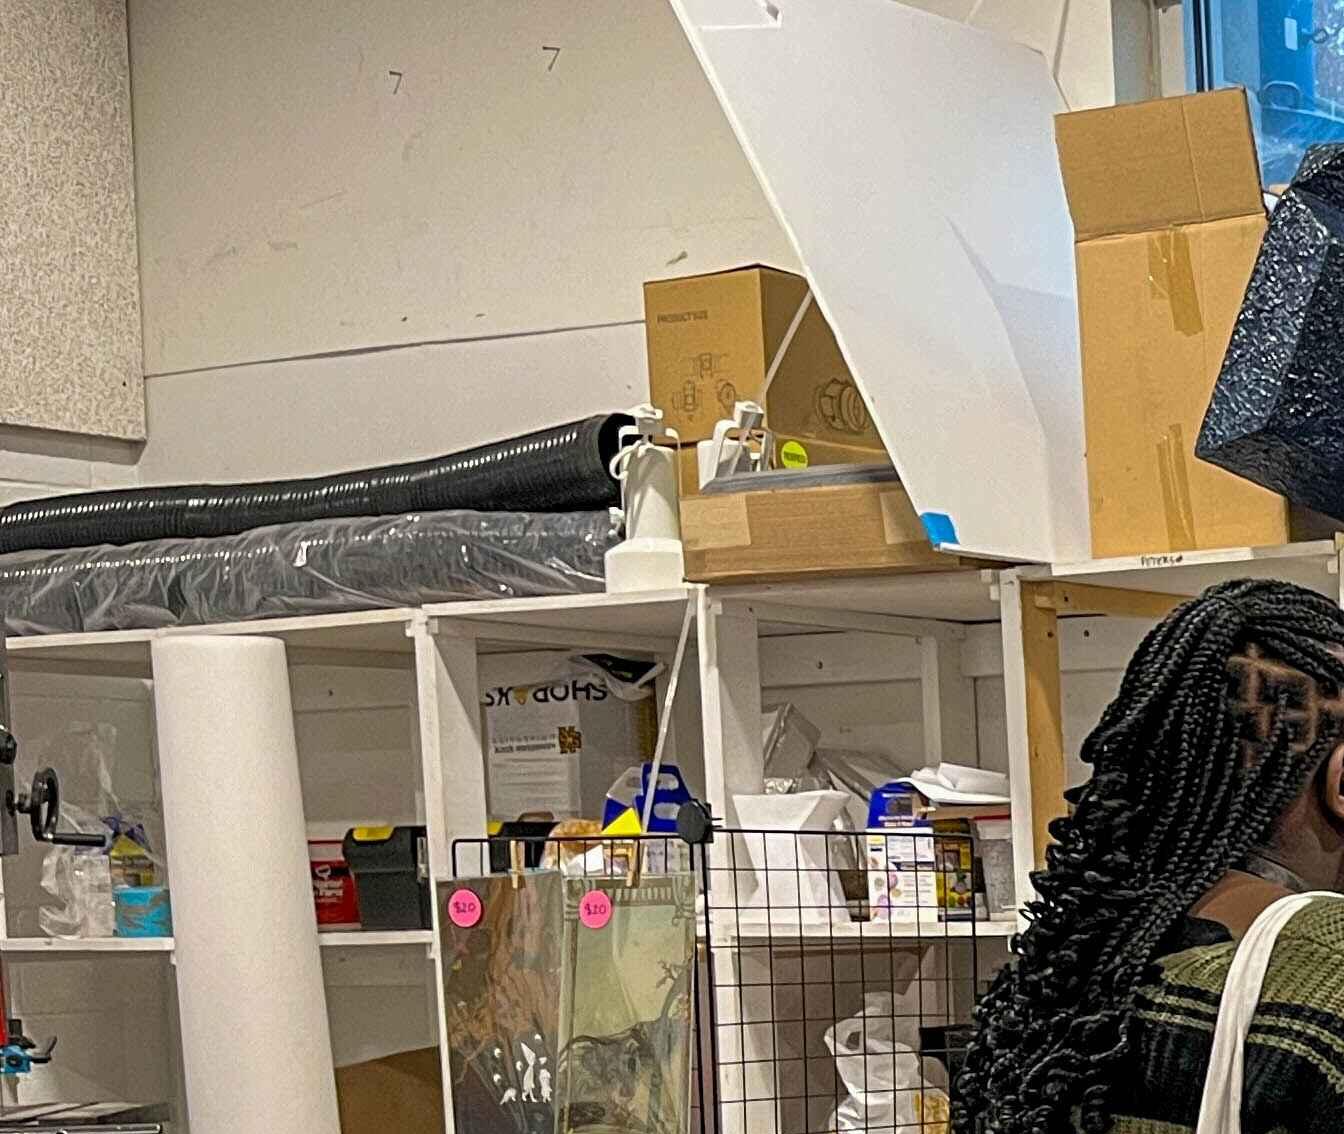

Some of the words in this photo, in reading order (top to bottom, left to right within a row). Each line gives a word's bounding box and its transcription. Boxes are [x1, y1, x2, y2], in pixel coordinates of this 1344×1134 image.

[533, 680, 607, 703] SHOP
[453, 902, 477, 913] $20
[584, 904, 607, 916] $20
